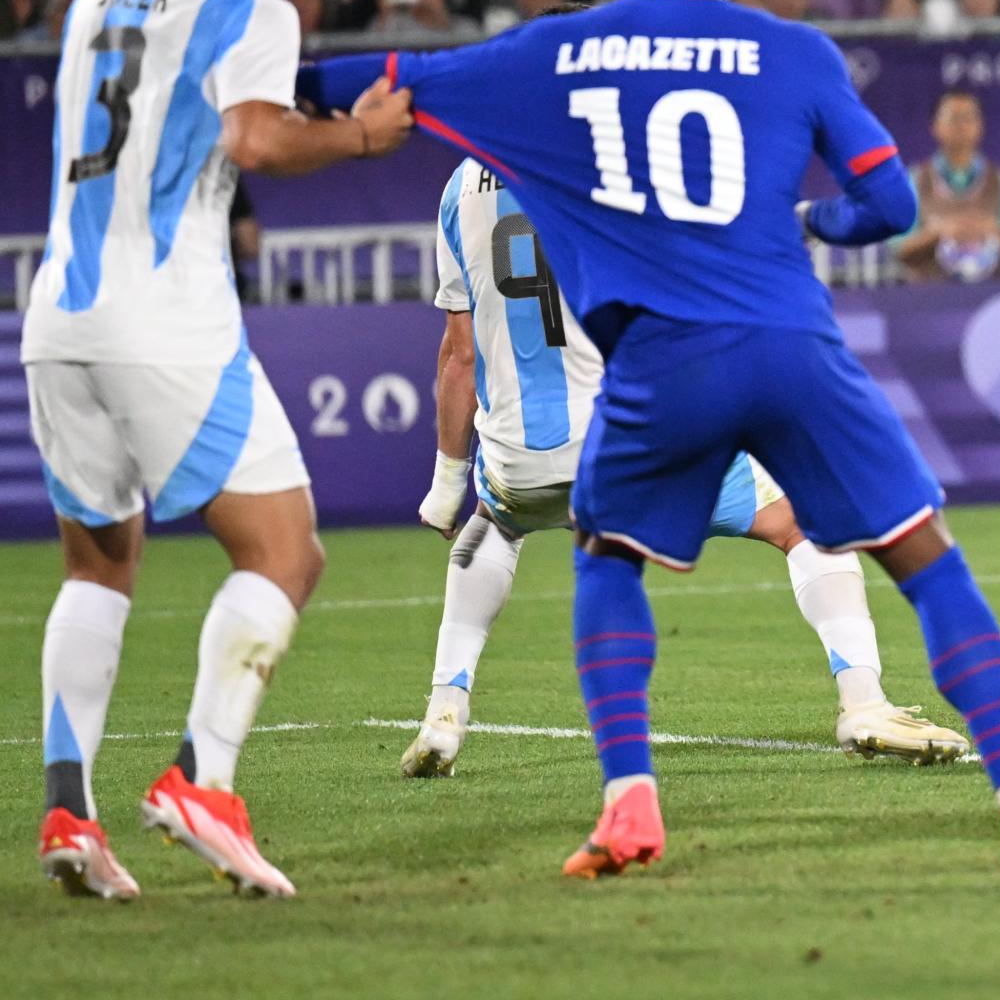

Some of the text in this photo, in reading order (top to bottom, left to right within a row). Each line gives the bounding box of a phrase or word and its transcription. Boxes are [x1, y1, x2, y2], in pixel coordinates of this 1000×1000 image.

[68, 26, 147, 183] 3
[568, 87, 745, 225] 10
[492, 213, 567, 347] 9
